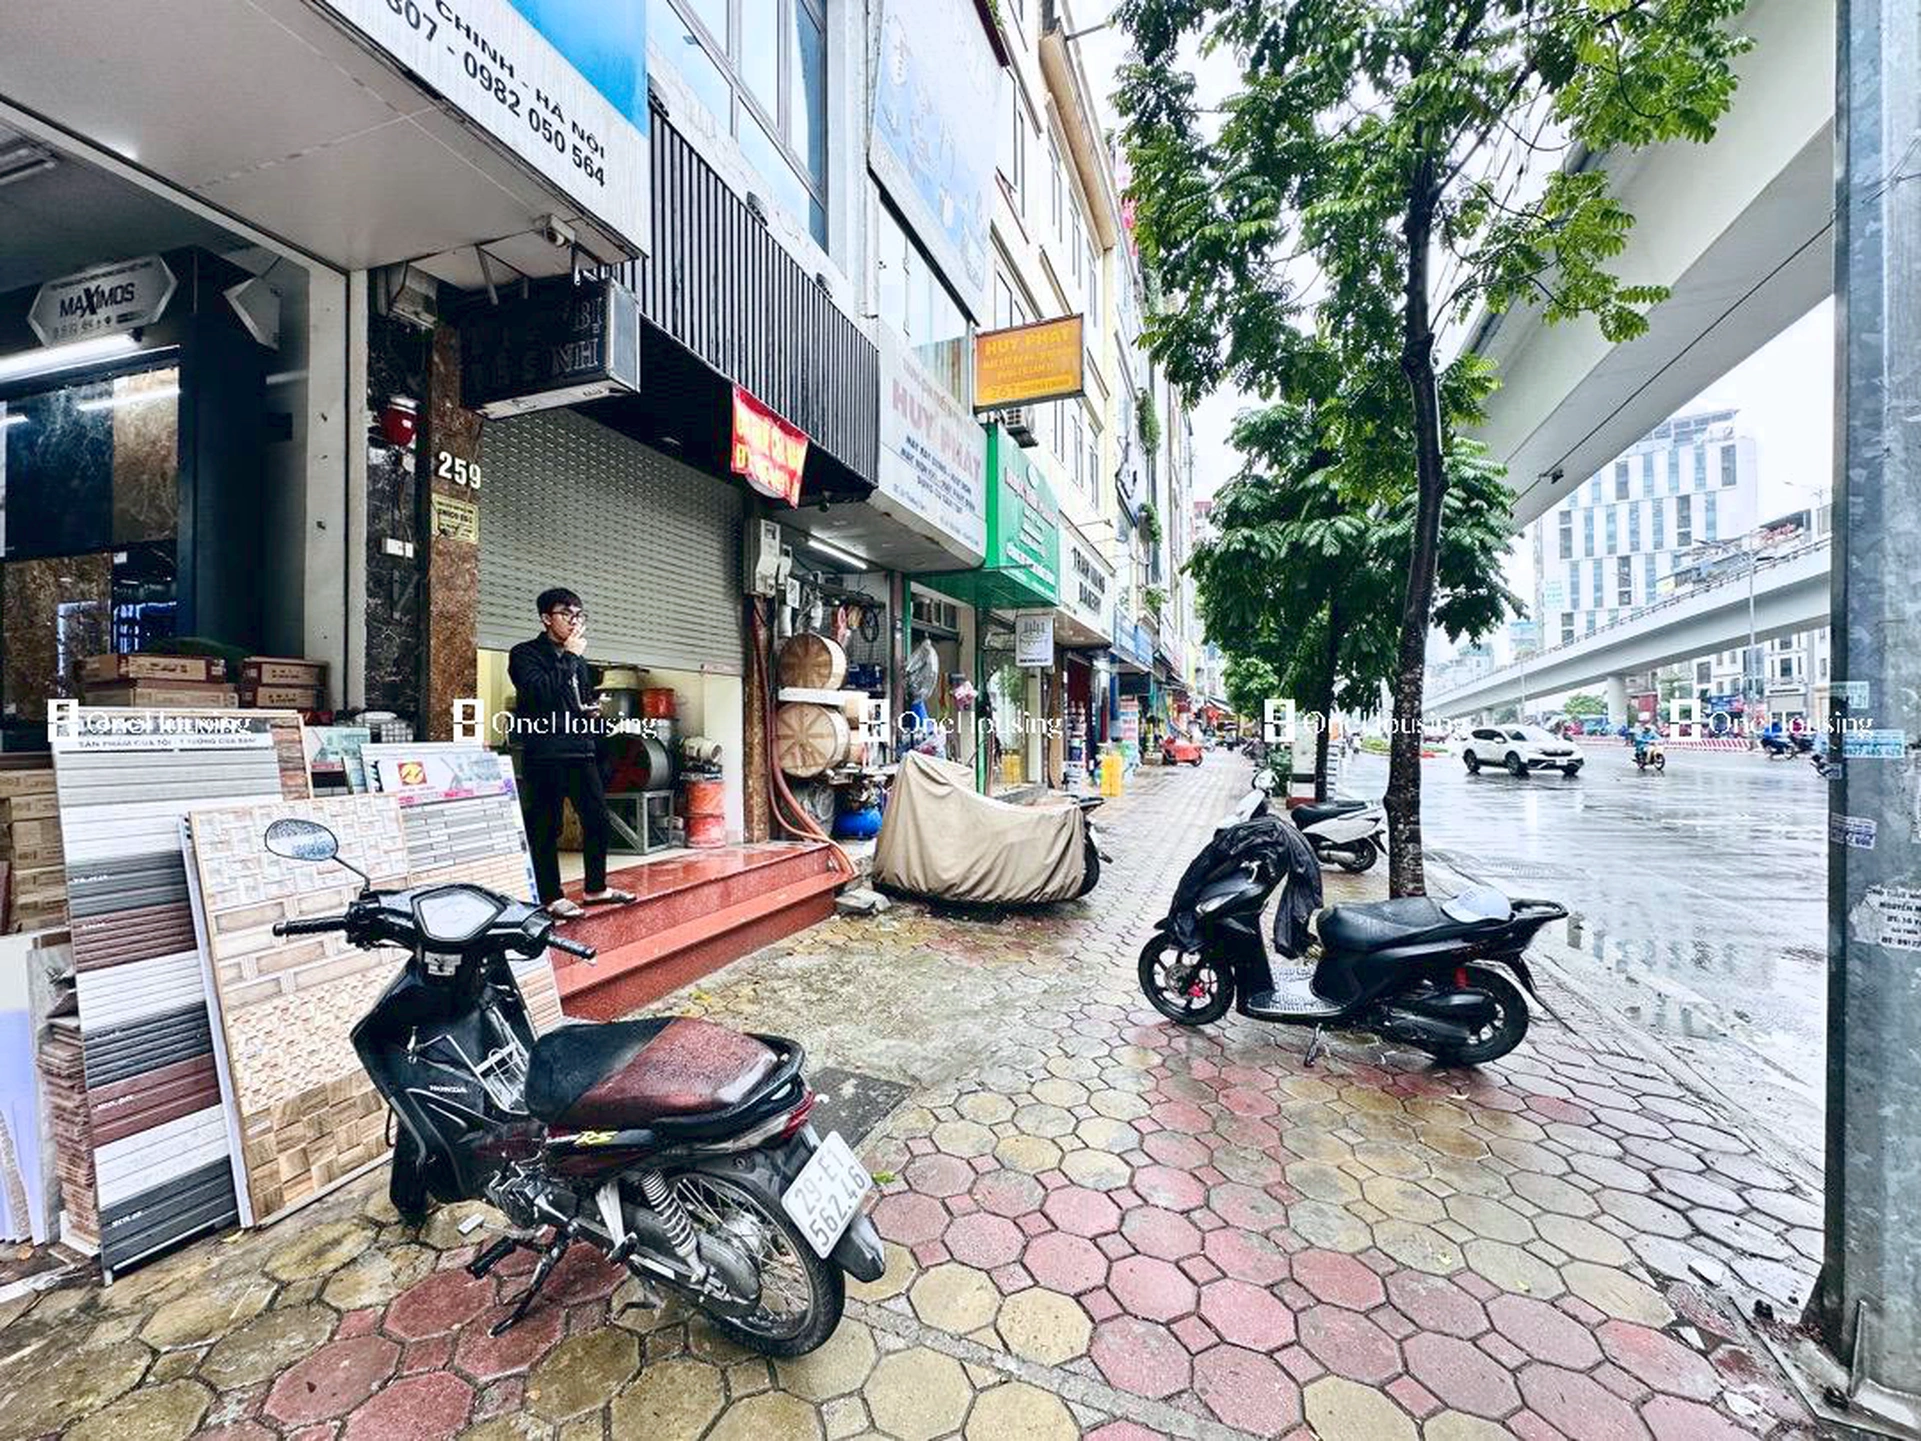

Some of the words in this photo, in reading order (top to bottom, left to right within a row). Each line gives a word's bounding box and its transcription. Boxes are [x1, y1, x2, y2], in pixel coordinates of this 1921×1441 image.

[463, 52, 521, 117] 0982
[528, 108, 565, 153] 050
[572, 145, 605, 187] 564
[571, 120, 605, 159] NỘI
[60, 282, 135, 318] MAXIMOS
[985, 340, 1018, 357] HUY
[893, 377, 934, 438] HUY
[438, 451, 480, 489] 259
[429, 1084, 467, 1094] HONDA
